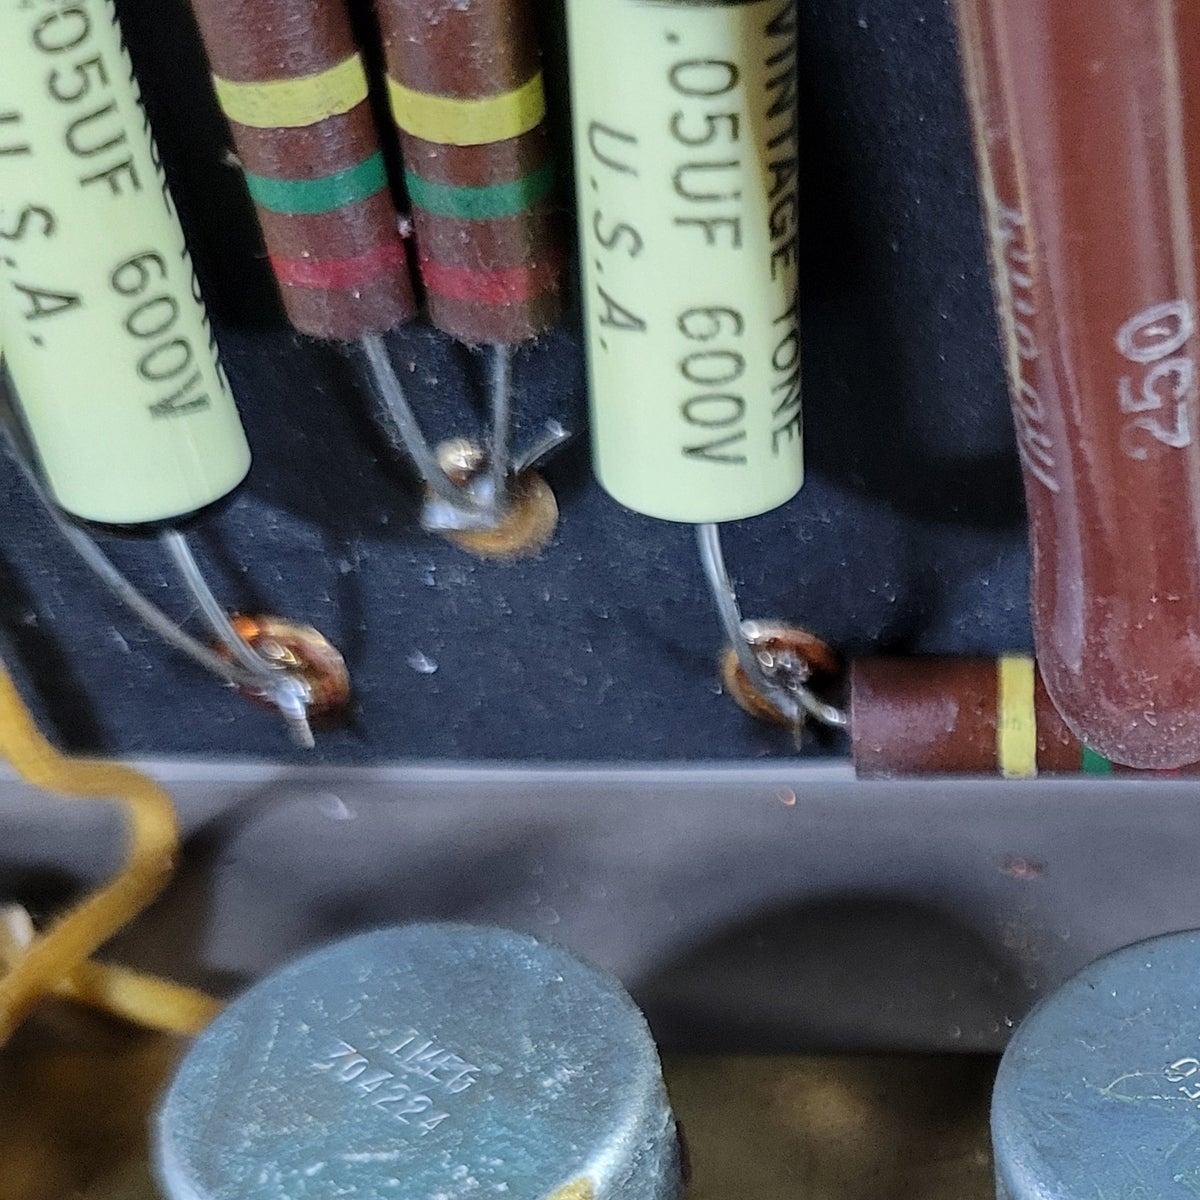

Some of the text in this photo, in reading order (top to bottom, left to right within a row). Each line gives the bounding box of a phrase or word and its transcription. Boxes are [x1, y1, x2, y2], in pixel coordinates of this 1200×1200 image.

[0, 110, 83, 348] S.A.
[110, 249, 211, 421] 600V
[588, 118, 648, 355] U.S.A.
[667, 28, 748, 467] .05UF 600V
[1116, 300, 1197, 462] 250
